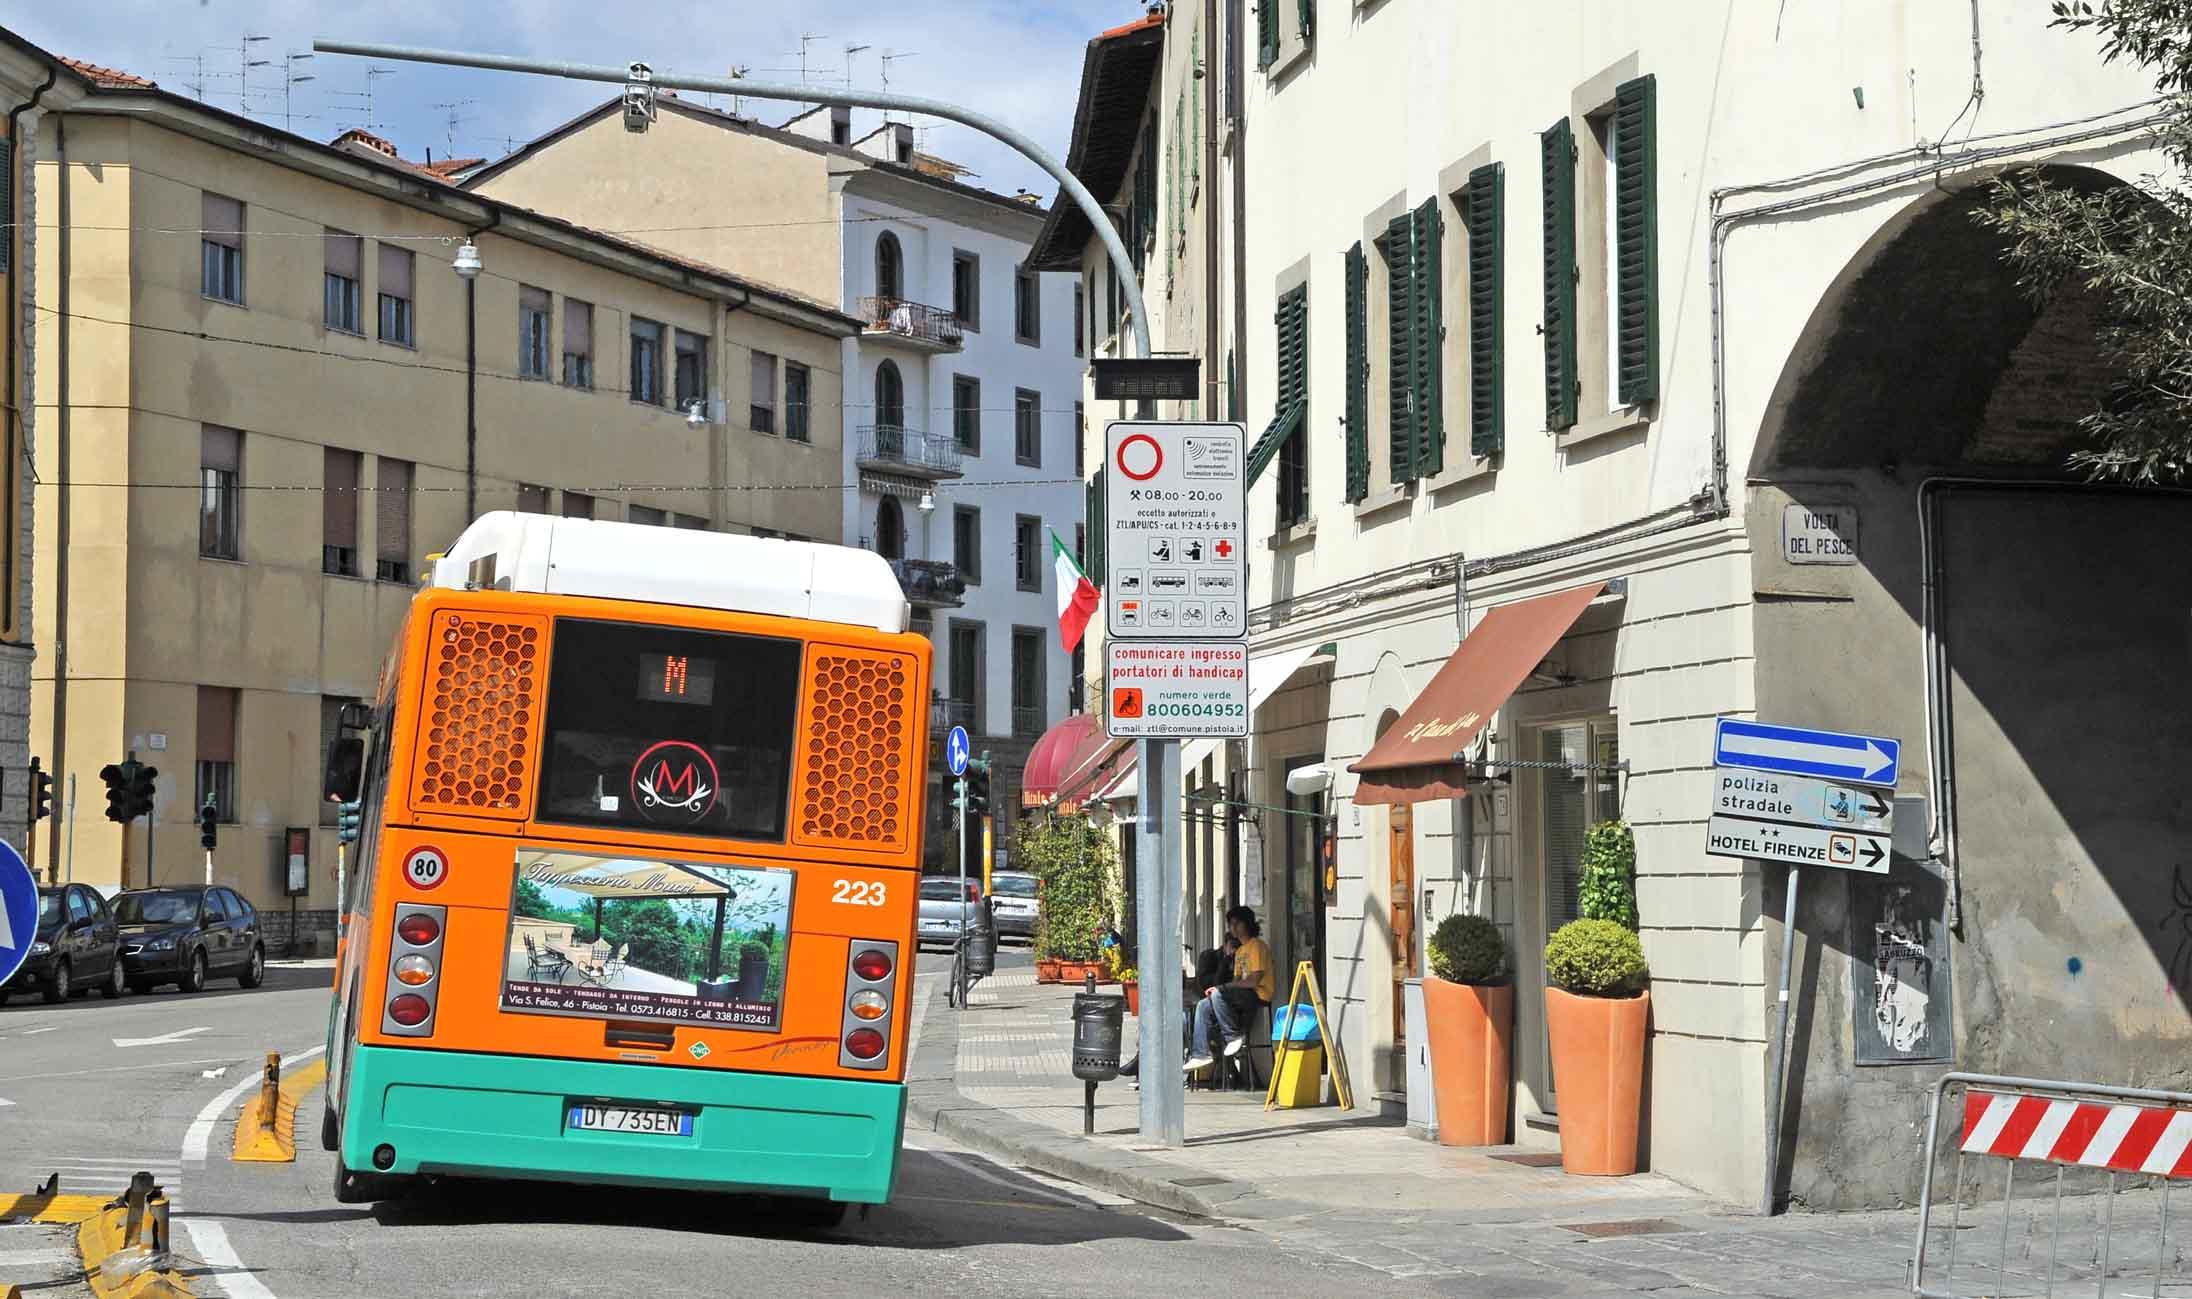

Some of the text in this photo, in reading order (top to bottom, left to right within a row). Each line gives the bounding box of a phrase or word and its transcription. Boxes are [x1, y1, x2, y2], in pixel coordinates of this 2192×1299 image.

[1144, 490, 1179, 501] 08.00
[1188, 490, 1223, 501] 20.00
[1137, 508, 1165, 518] eccetto
[1168, 508, 1209, 518] autorizzati
[1803, 513, 1839, 530] VOLTA
[1790, 537, 1853, 555] DEL PESCE
[1115, 646, 1241, 663] comunicare ingresso
[664, 655, 688, 694] M
[1112, 664, 1243, 681] portatori di handicap
[1159, 690, 1231, 700] numero verde
[1147, 703, 1244, 717] 800604952
[1147, 724, 1244, 734] ztl@comune.pistoia.it
[1722, 776, 1779, 794] polizia
[1721, 795, 1793, 815] stradale
[1710, 834, 1826, 861] HOTEL FIRENZE
[414, 858, 437, 877] 80
[831, 879, 887, 907] 223
[509, 994, 523, 1005] Via
[525, 996, 534, 1006] S.
[536, 996, 561, 1008] Felice,
[562, 999, 575, 1009] 46
[581, 1001, 608, 1012] Pistoia
[615, 1003, 629, 1013] Tel.
[630, 1004, 689, 1018] 0573.416815
[695, 1009, 713, 1020] Cell.
[715, 1010, 771, 1025] 338.8152451
[583, 1105, 610, 1127] DY
[616, 1108, 681, 1132] 735EN
